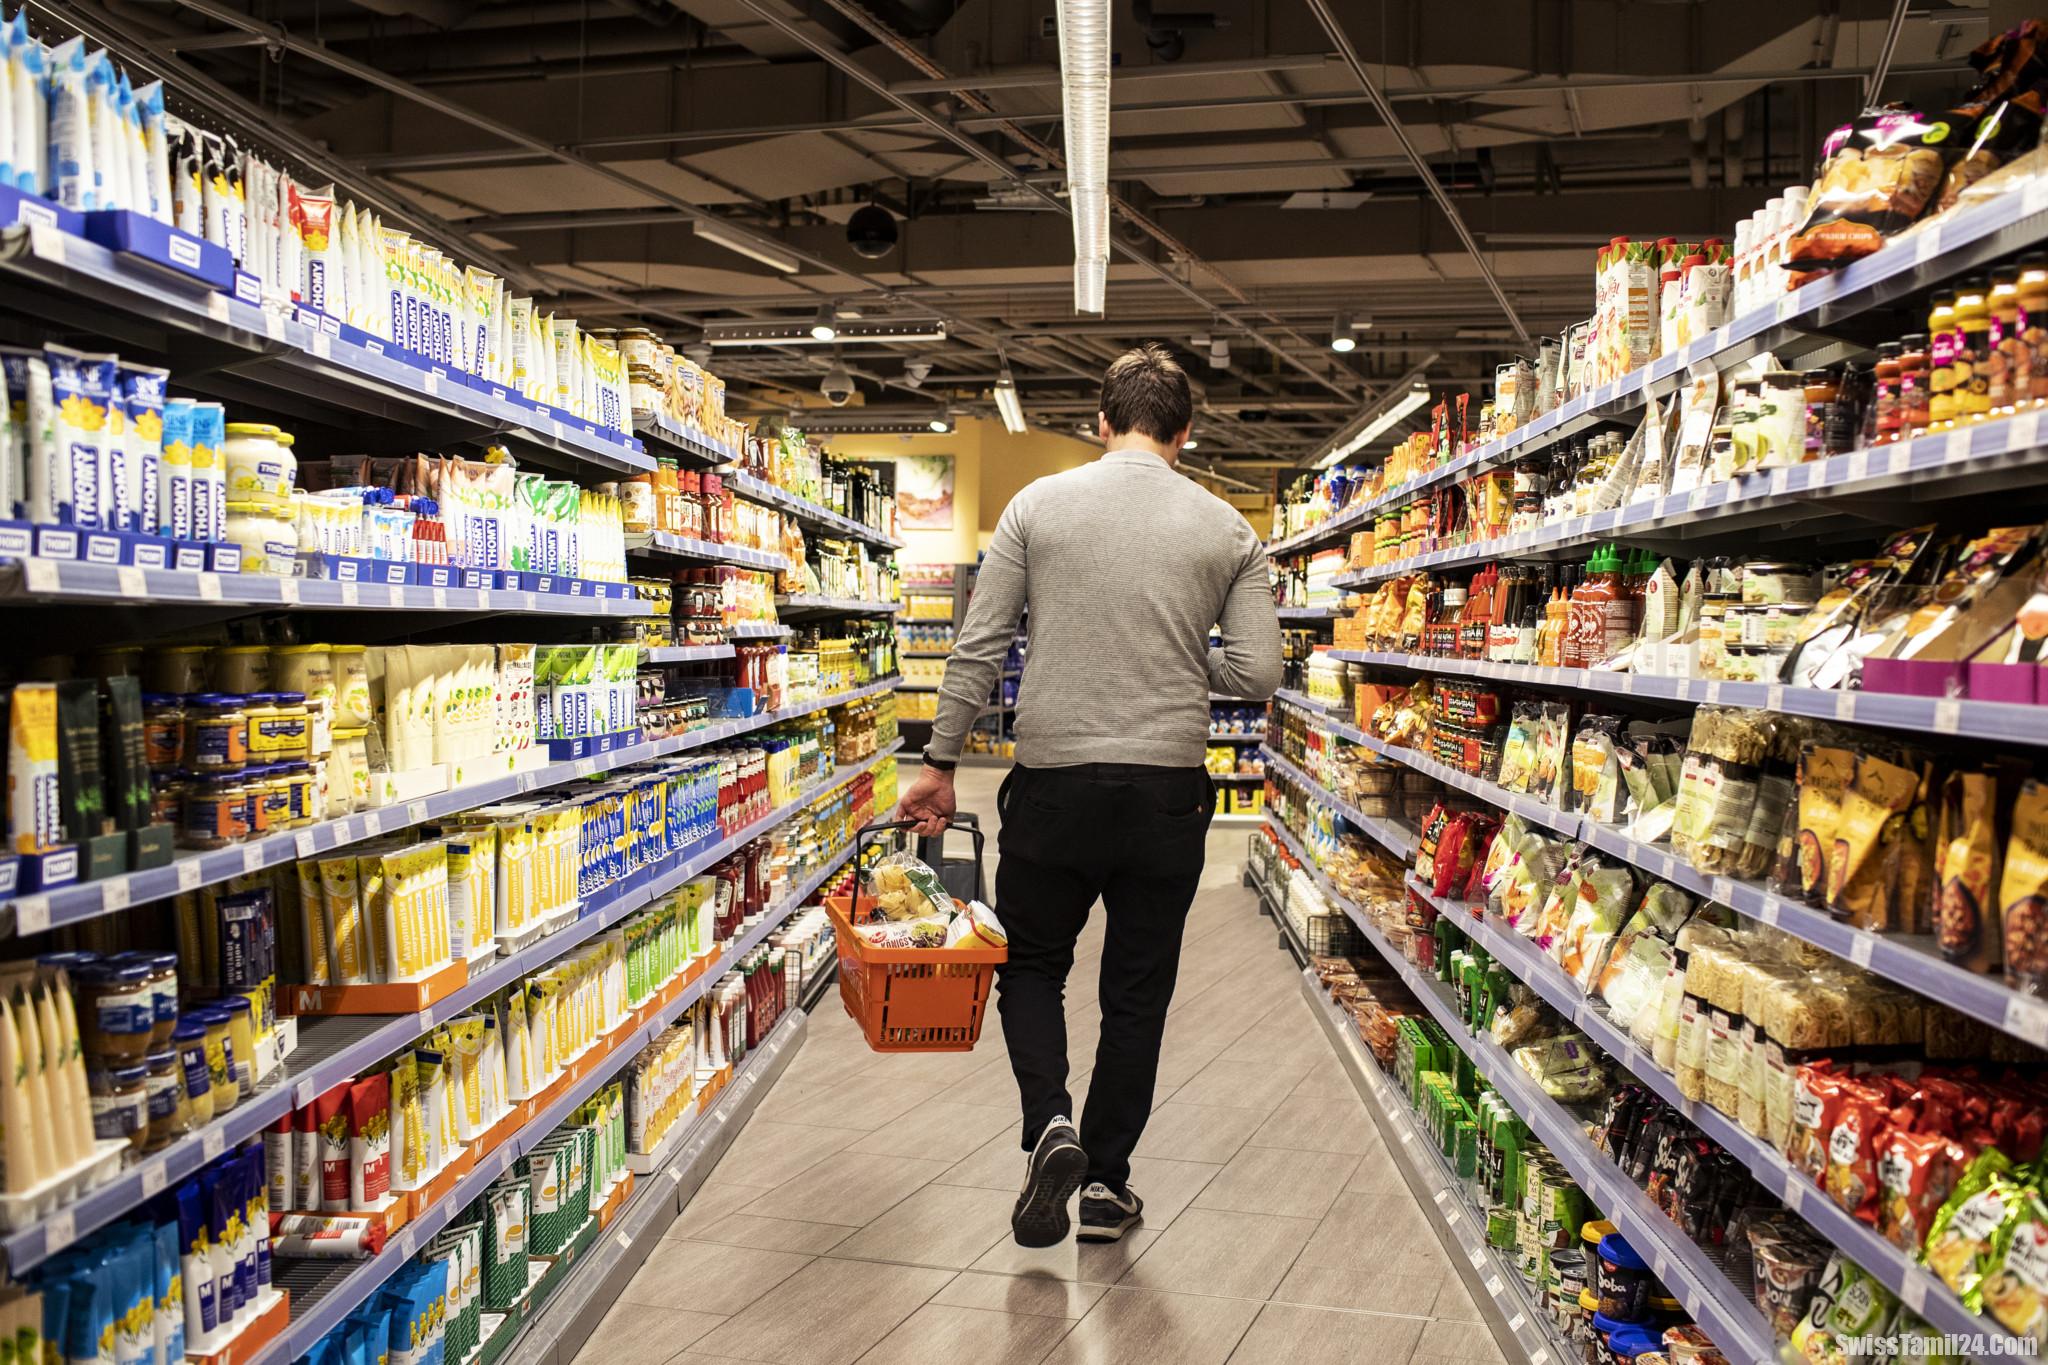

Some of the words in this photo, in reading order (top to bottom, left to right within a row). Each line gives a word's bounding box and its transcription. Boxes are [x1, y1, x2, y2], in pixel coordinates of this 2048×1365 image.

[312, 262, 324, 309] THOMY
[393, 293, 404, 345] THOMY
[409, 299, 418, 351] THOMY
[421, 304, 430, 356] THOMY
[433, 311, 441, 361] THOMY
[443, 314, 452, 364] THOMY
[476, 328, 486, 376] THOMY
[73, 444, 97, 524] THOMY
[112, 451, 130, 526] THOMY
[143, 458, 157, 531] THOMY
[173, 479, 186, 538] THOMY
[194, 482, 207, 539] THOMY
[487, 519, 497, 567] THOMY
[547, 530, 557, 573] THOMY
[540, 696, 548, 737] THOMY
[564, 695, 573, 735] THOMY
[578, 694, 587, 734] THOMY
[512, 864, 521, 916] Mayonnaise
[400, 901, 413, 961] Mayonnaise
[300, 990, 322, 1010] M
[421, 983, 430, 1003] M
[184, 1051, 197, 1066] M
[572, 1065, 578, 1082] M
[469, 1058, 480, 1113] Mayonnaise
[529, 1099, 536, 1118] M
[406, 1107, 416, 1167] Mayonnaise
[475, 1139, 483, 1159] M
[1654, 1136, 1677, 1171] Soba
[324, 1161, 335, 1172] M
[365, 1163, 375, 1174] M
[386, 1213, 393, 1230] M
[419, 1191, 428, 1211] M
[258, 1240, 268, 1252] M
[201, 1284, 212, 1298] M
[222, 1277, 233, 1289] M
[1598, 1264, 1627, 1293] Soba
